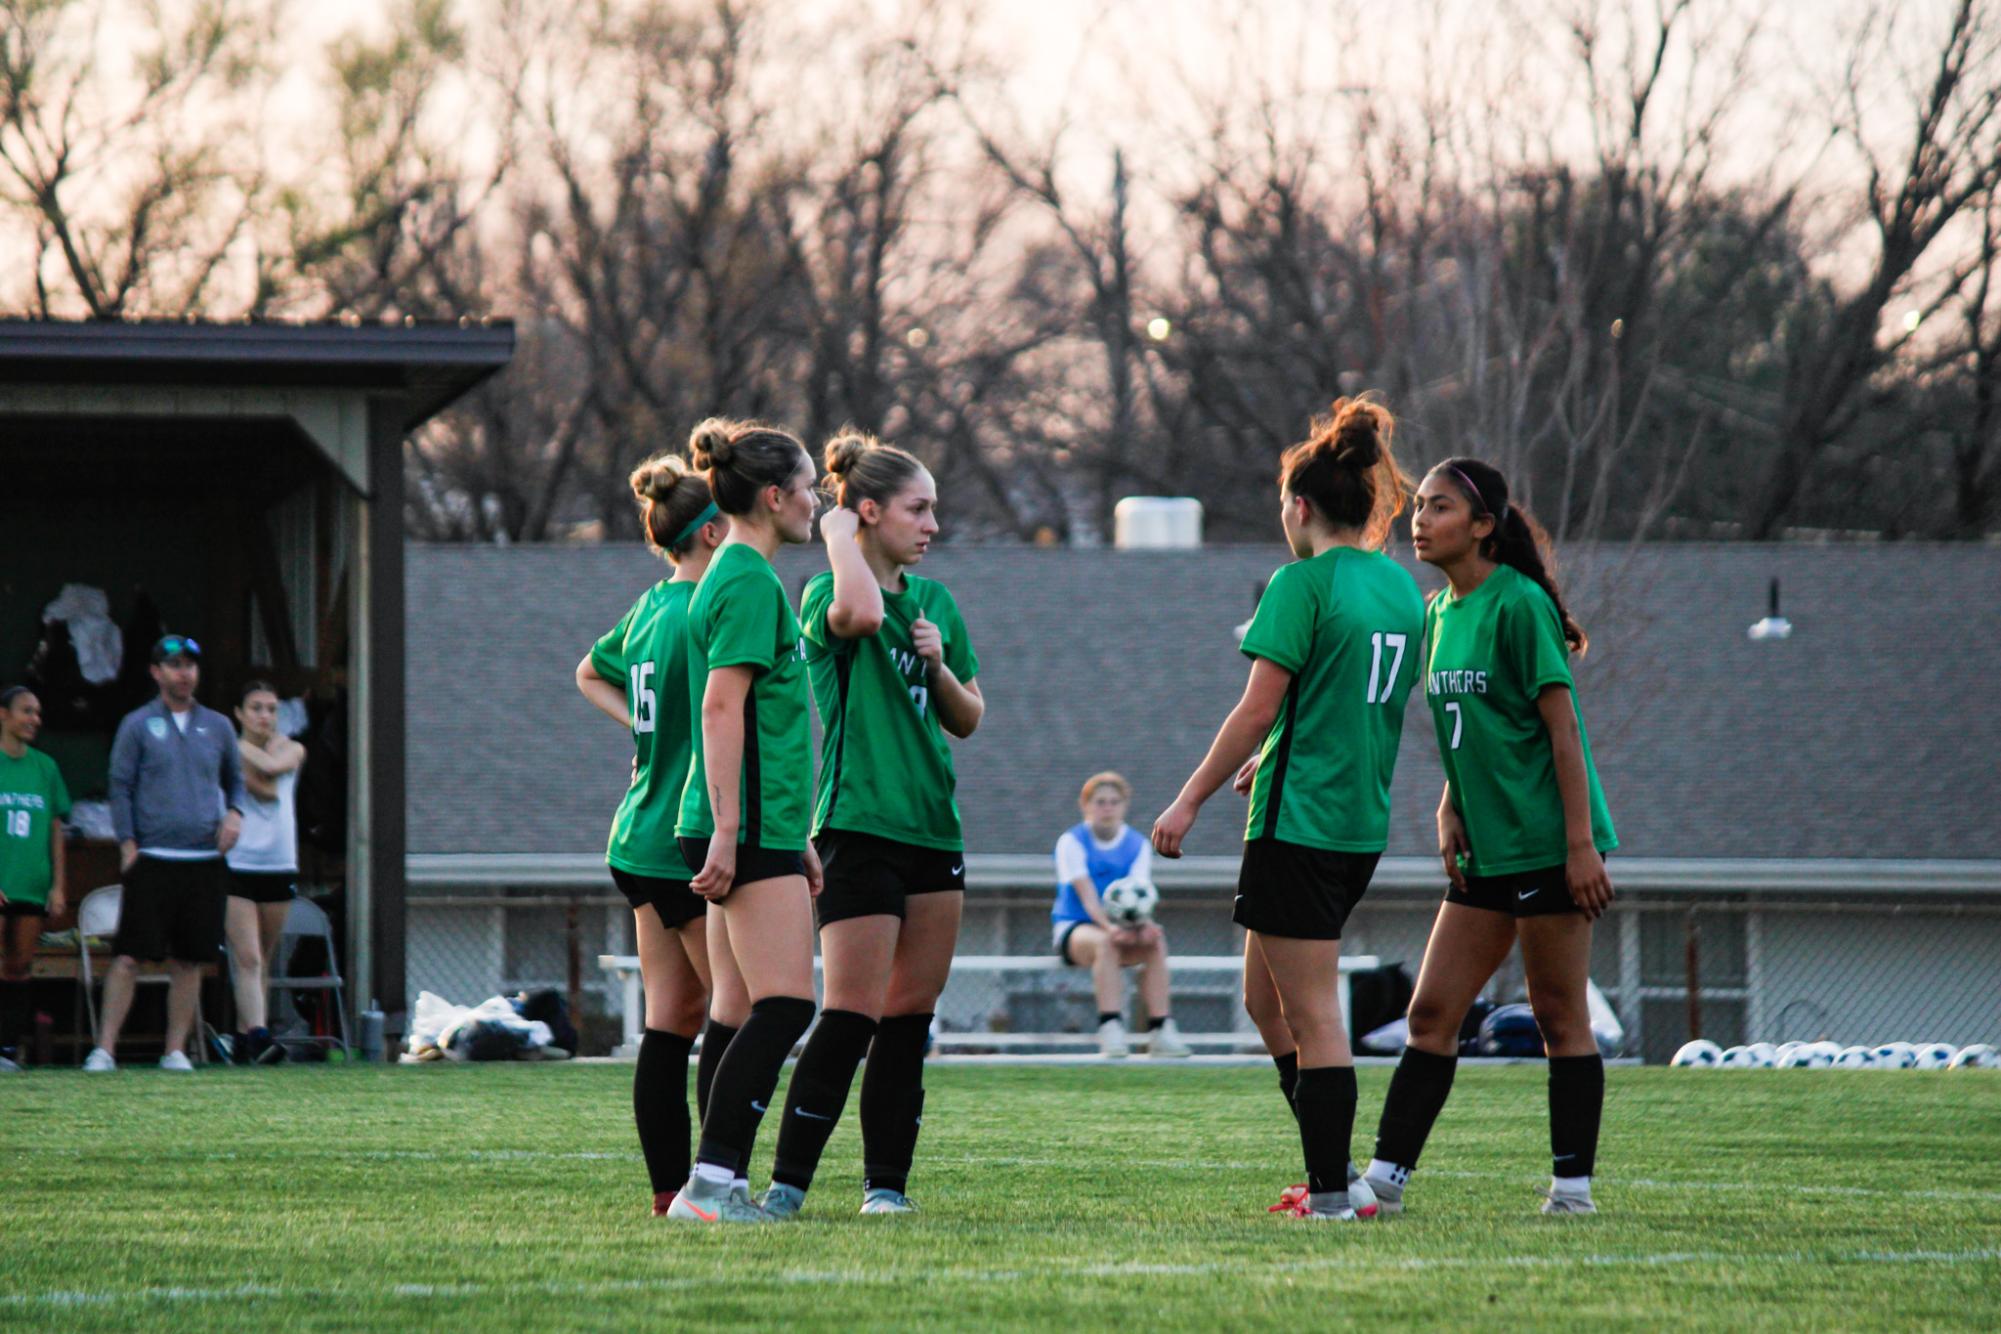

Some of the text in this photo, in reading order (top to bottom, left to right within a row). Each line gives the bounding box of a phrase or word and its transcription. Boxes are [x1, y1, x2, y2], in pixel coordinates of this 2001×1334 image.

[1366, 632, 1407, 704] 17
[1430, 669, 1487, 695] NTHERS
[1445, 702, 1463, 749] 7
[7, 809, 31, 838] 18
